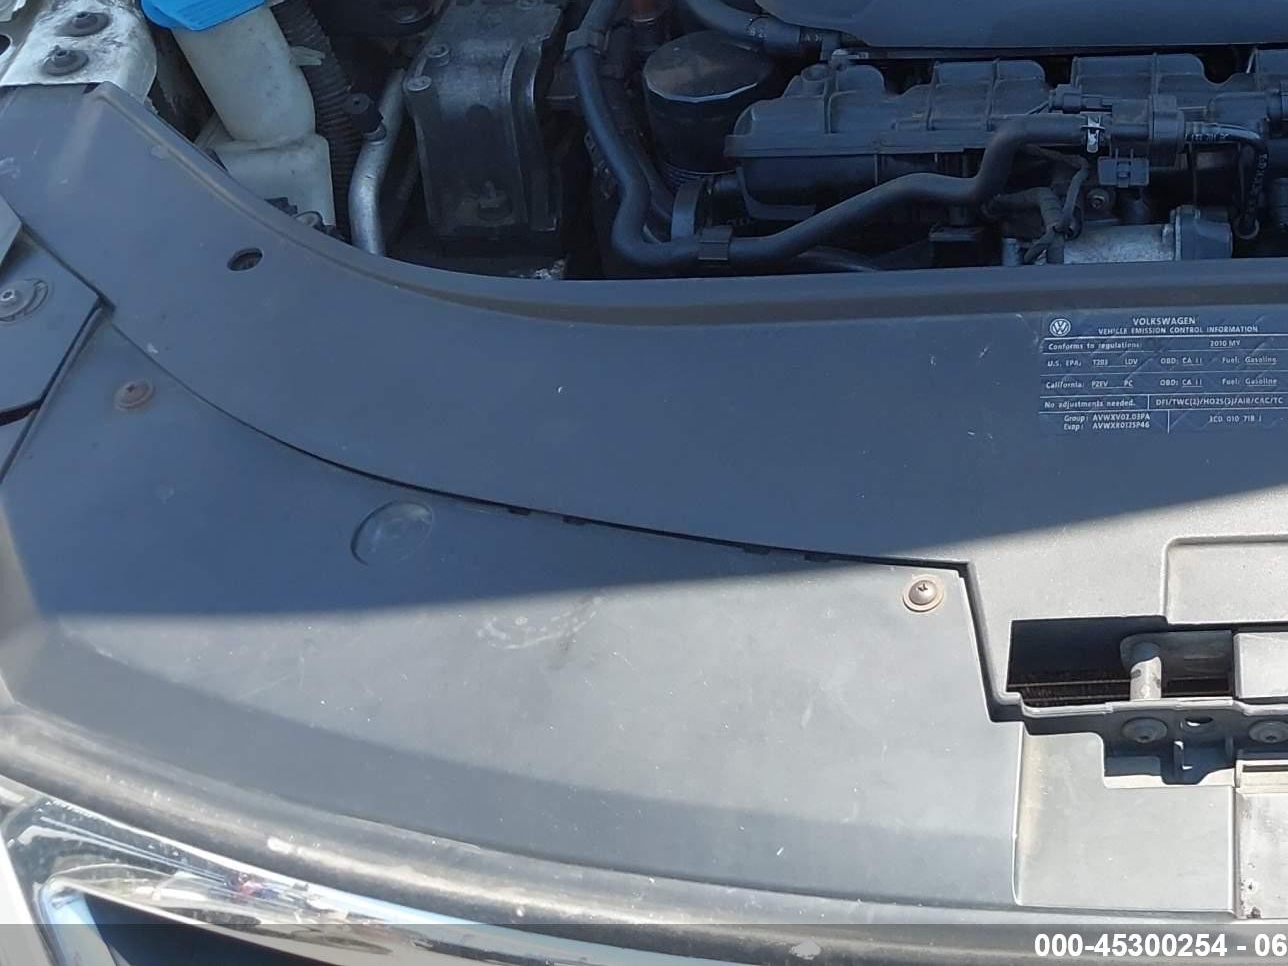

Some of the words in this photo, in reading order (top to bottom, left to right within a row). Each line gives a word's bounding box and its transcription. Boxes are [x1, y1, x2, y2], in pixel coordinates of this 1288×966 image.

[1133, 317, 1196, 326] VOLKSWAGEN
[1169, 326, 1204, 334] CONTROL
[1206, 325, 1258, 333] INFORMATION
[1124, 379, 1133, 387] PC
[1058, 400, 1104, 409] adjustments
